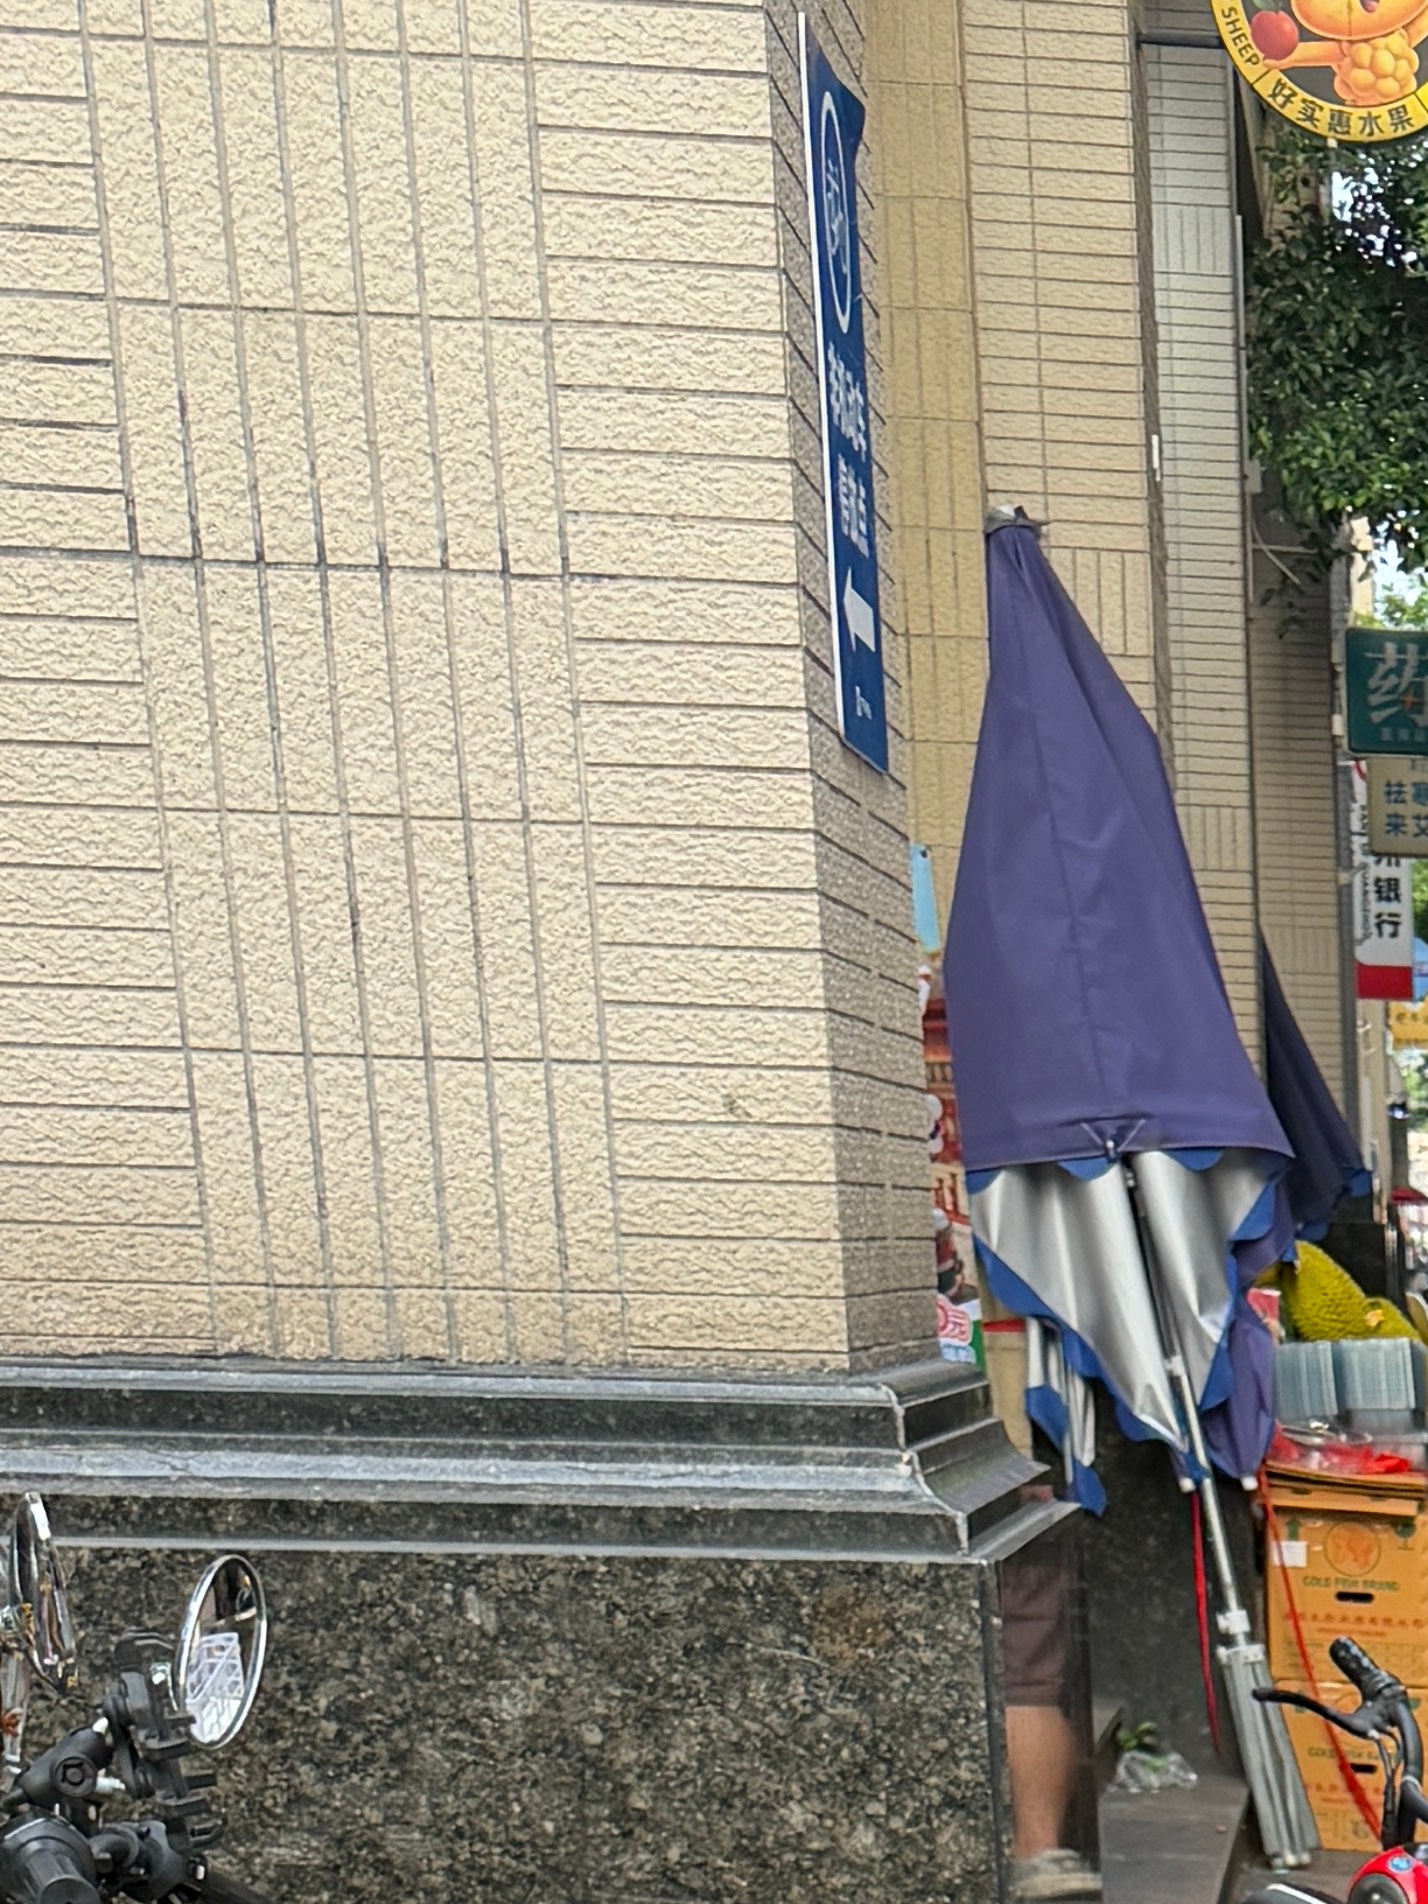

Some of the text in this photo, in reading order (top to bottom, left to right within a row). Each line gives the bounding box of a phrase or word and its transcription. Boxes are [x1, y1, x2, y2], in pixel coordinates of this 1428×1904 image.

[1220, 6, 1260, 66] SHEEP
[1268, 78, 1415, 138] 好实惠水果
